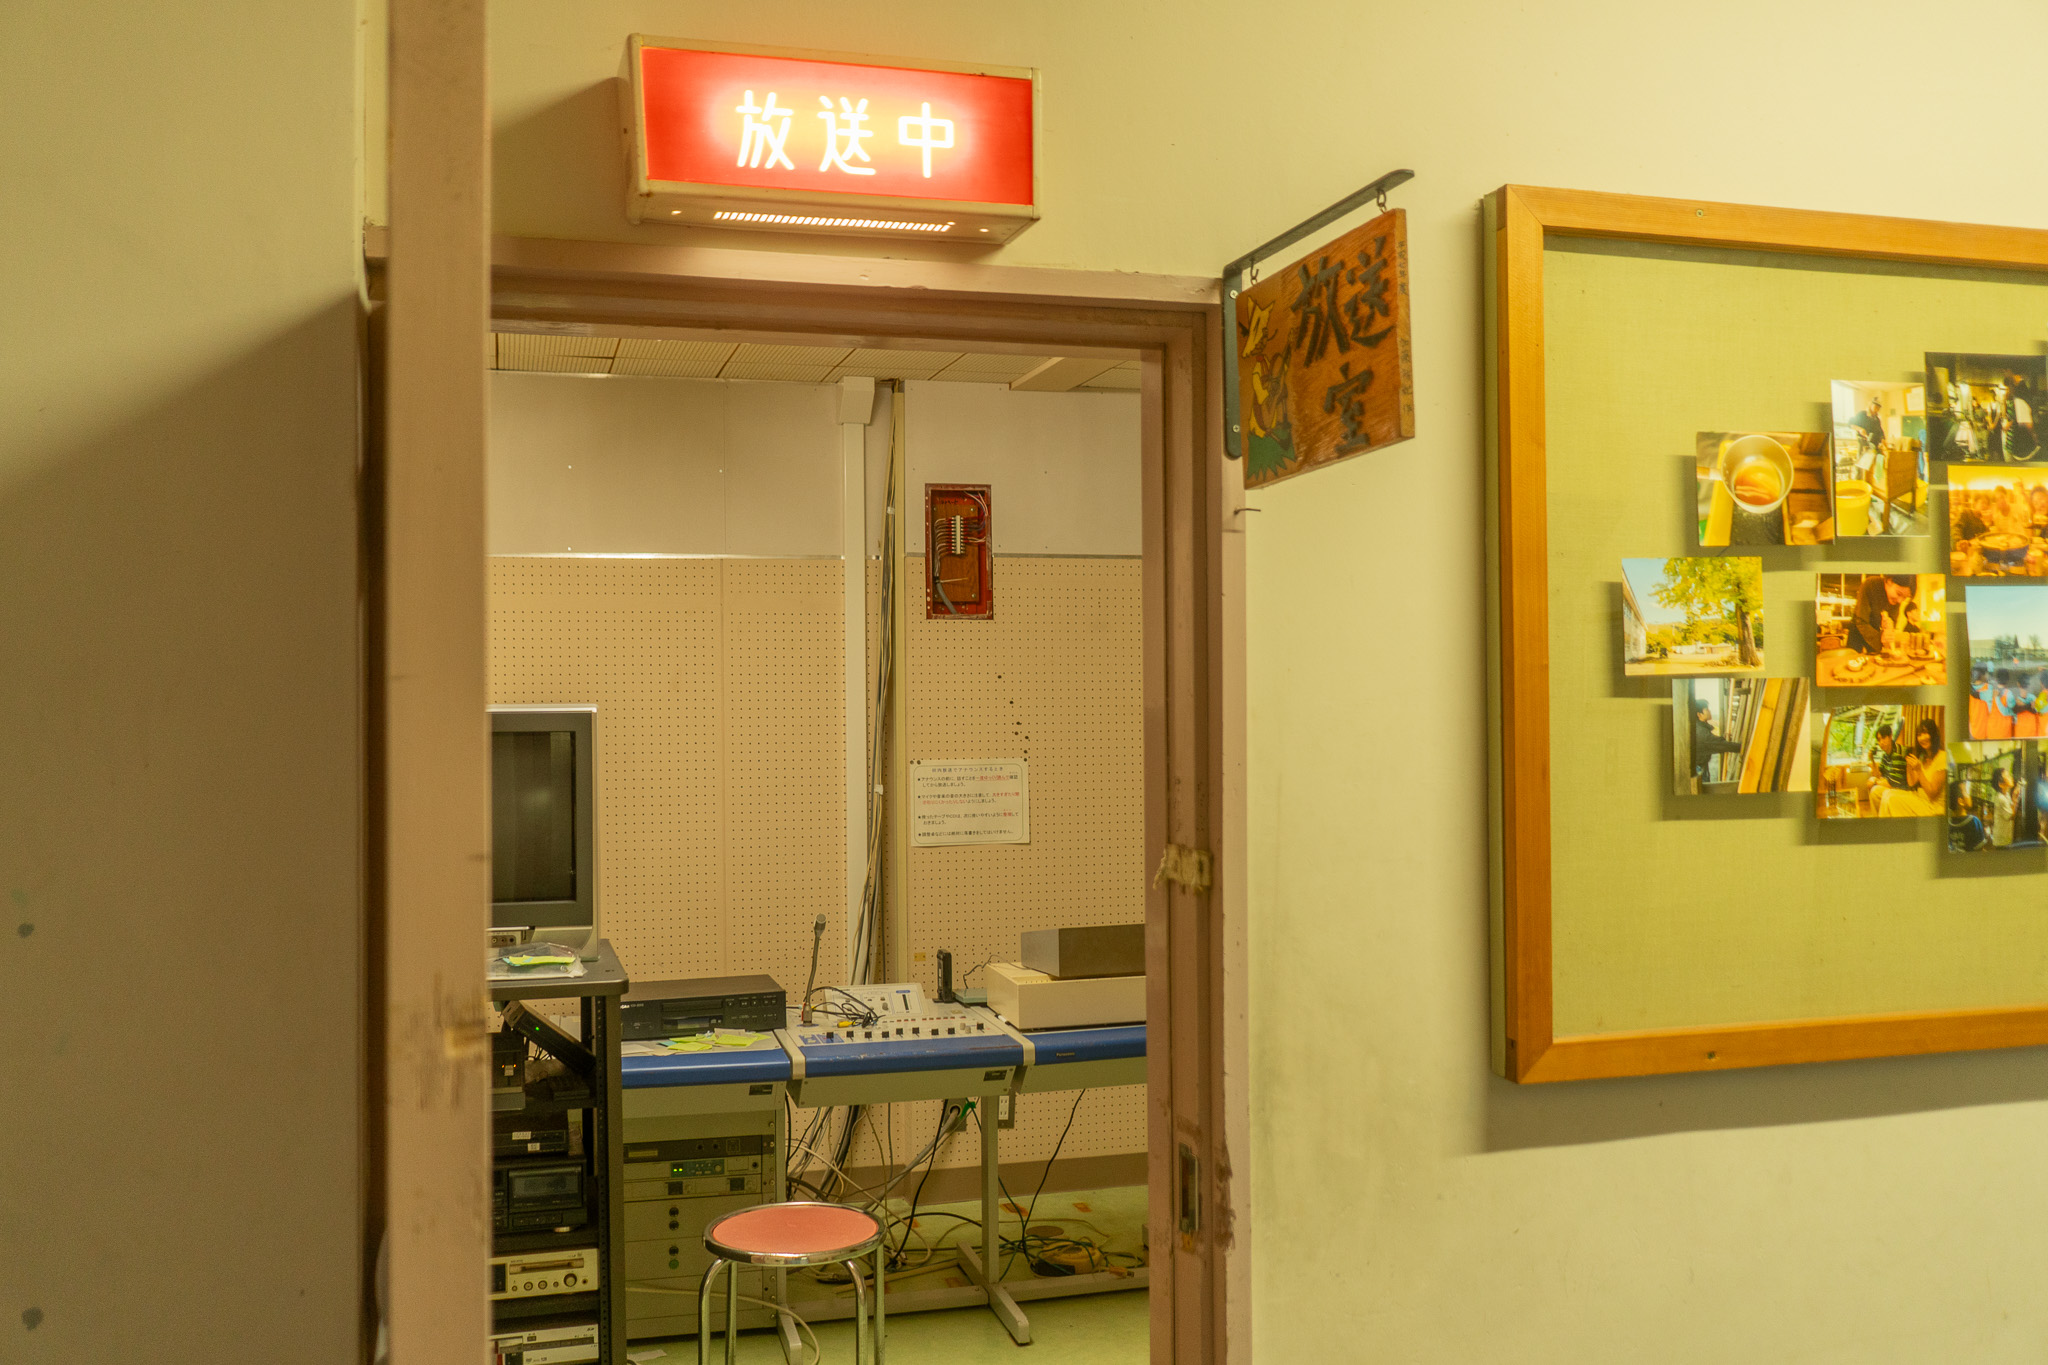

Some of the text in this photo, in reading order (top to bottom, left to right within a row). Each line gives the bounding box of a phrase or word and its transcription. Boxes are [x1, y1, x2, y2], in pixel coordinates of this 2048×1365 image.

[734, 89, 956, 179] 放送中
[1290, 235, 1396, 369] 放送
[1324, 361, 1375, 459] 室
